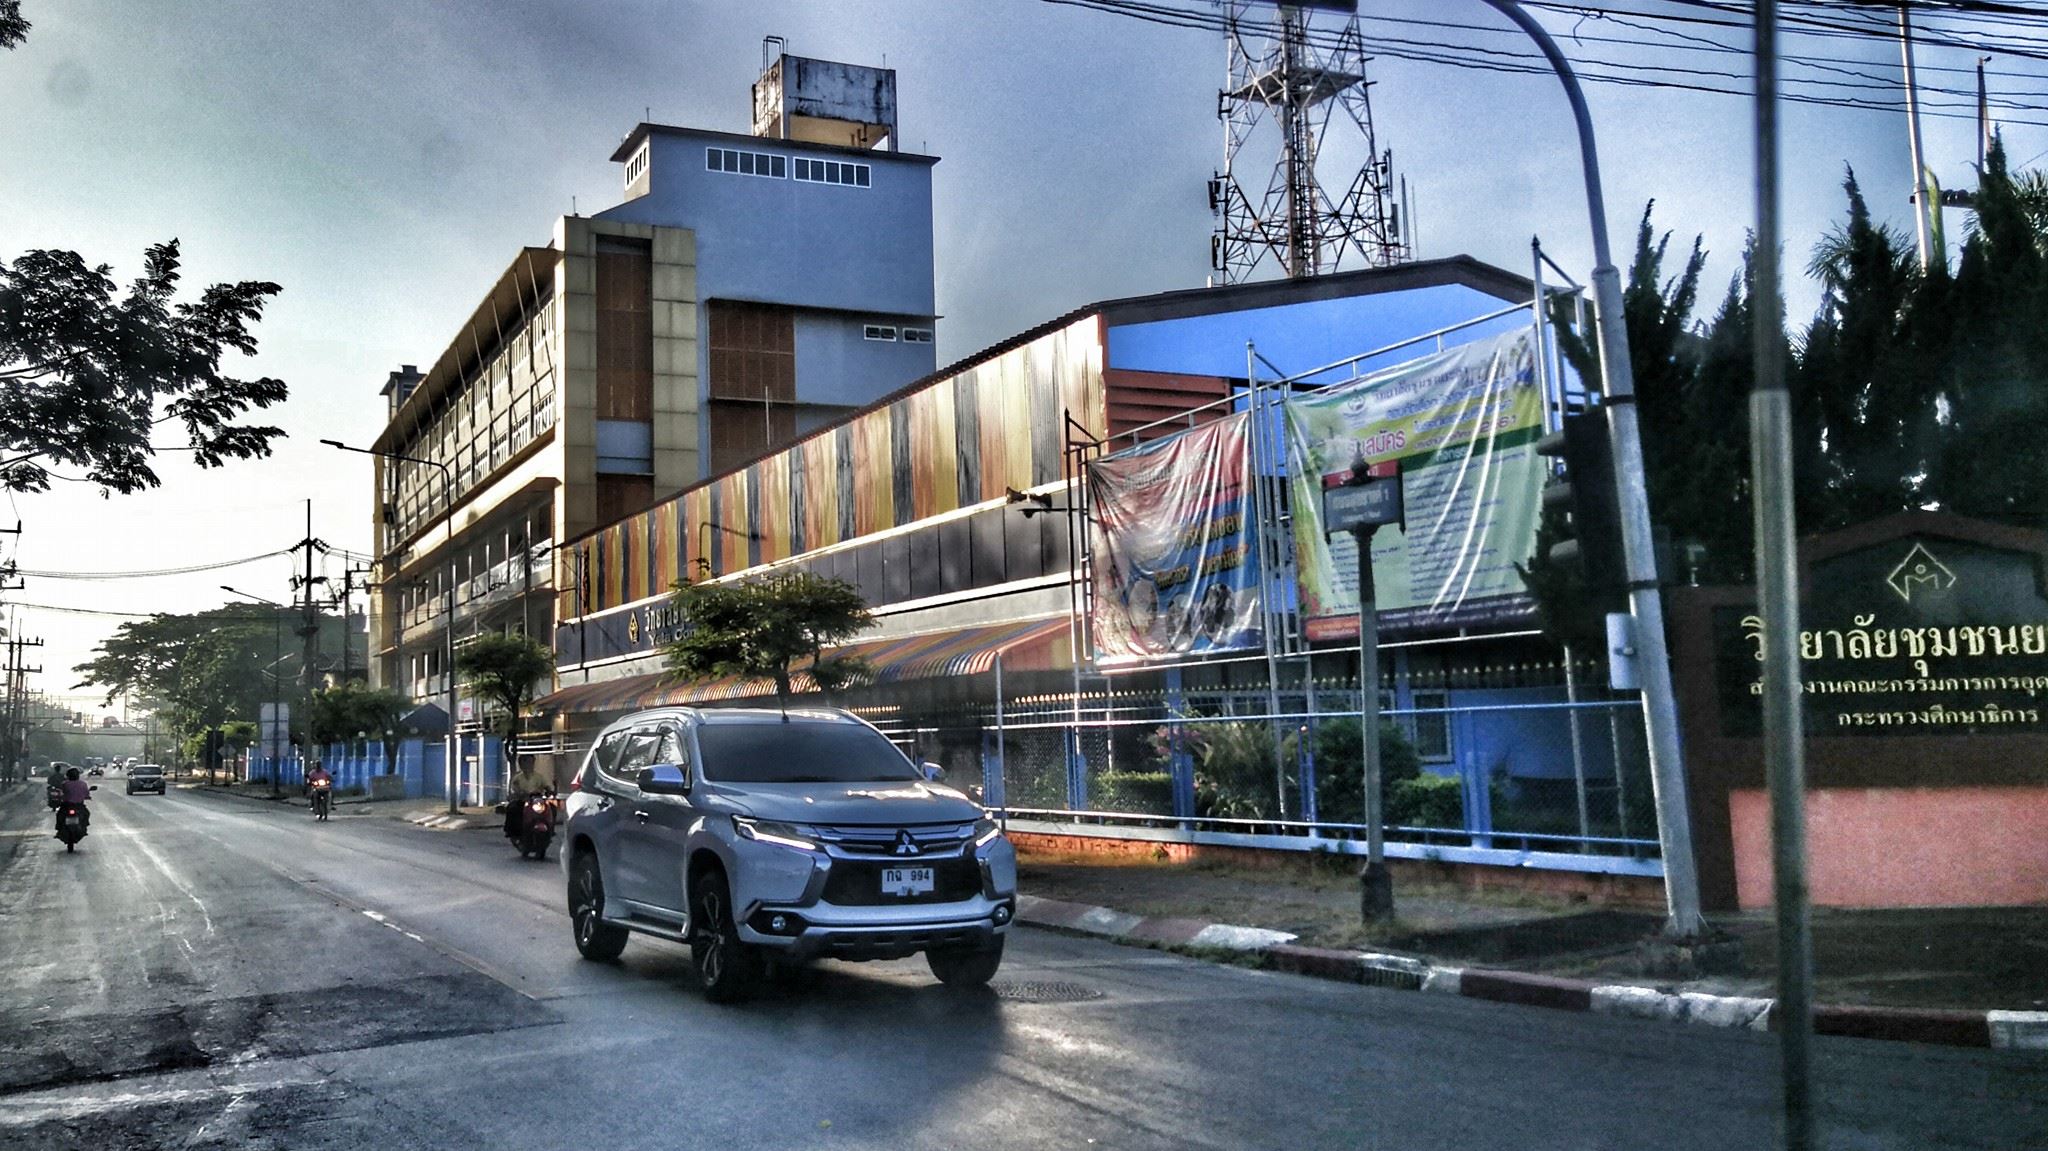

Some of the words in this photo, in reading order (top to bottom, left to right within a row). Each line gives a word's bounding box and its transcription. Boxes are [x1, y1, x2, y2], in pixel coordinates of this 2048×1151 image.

[1838, 703, 2038, 725] กระทรวงศึกษาธิการ
[910, 869, 930, 881] 994
